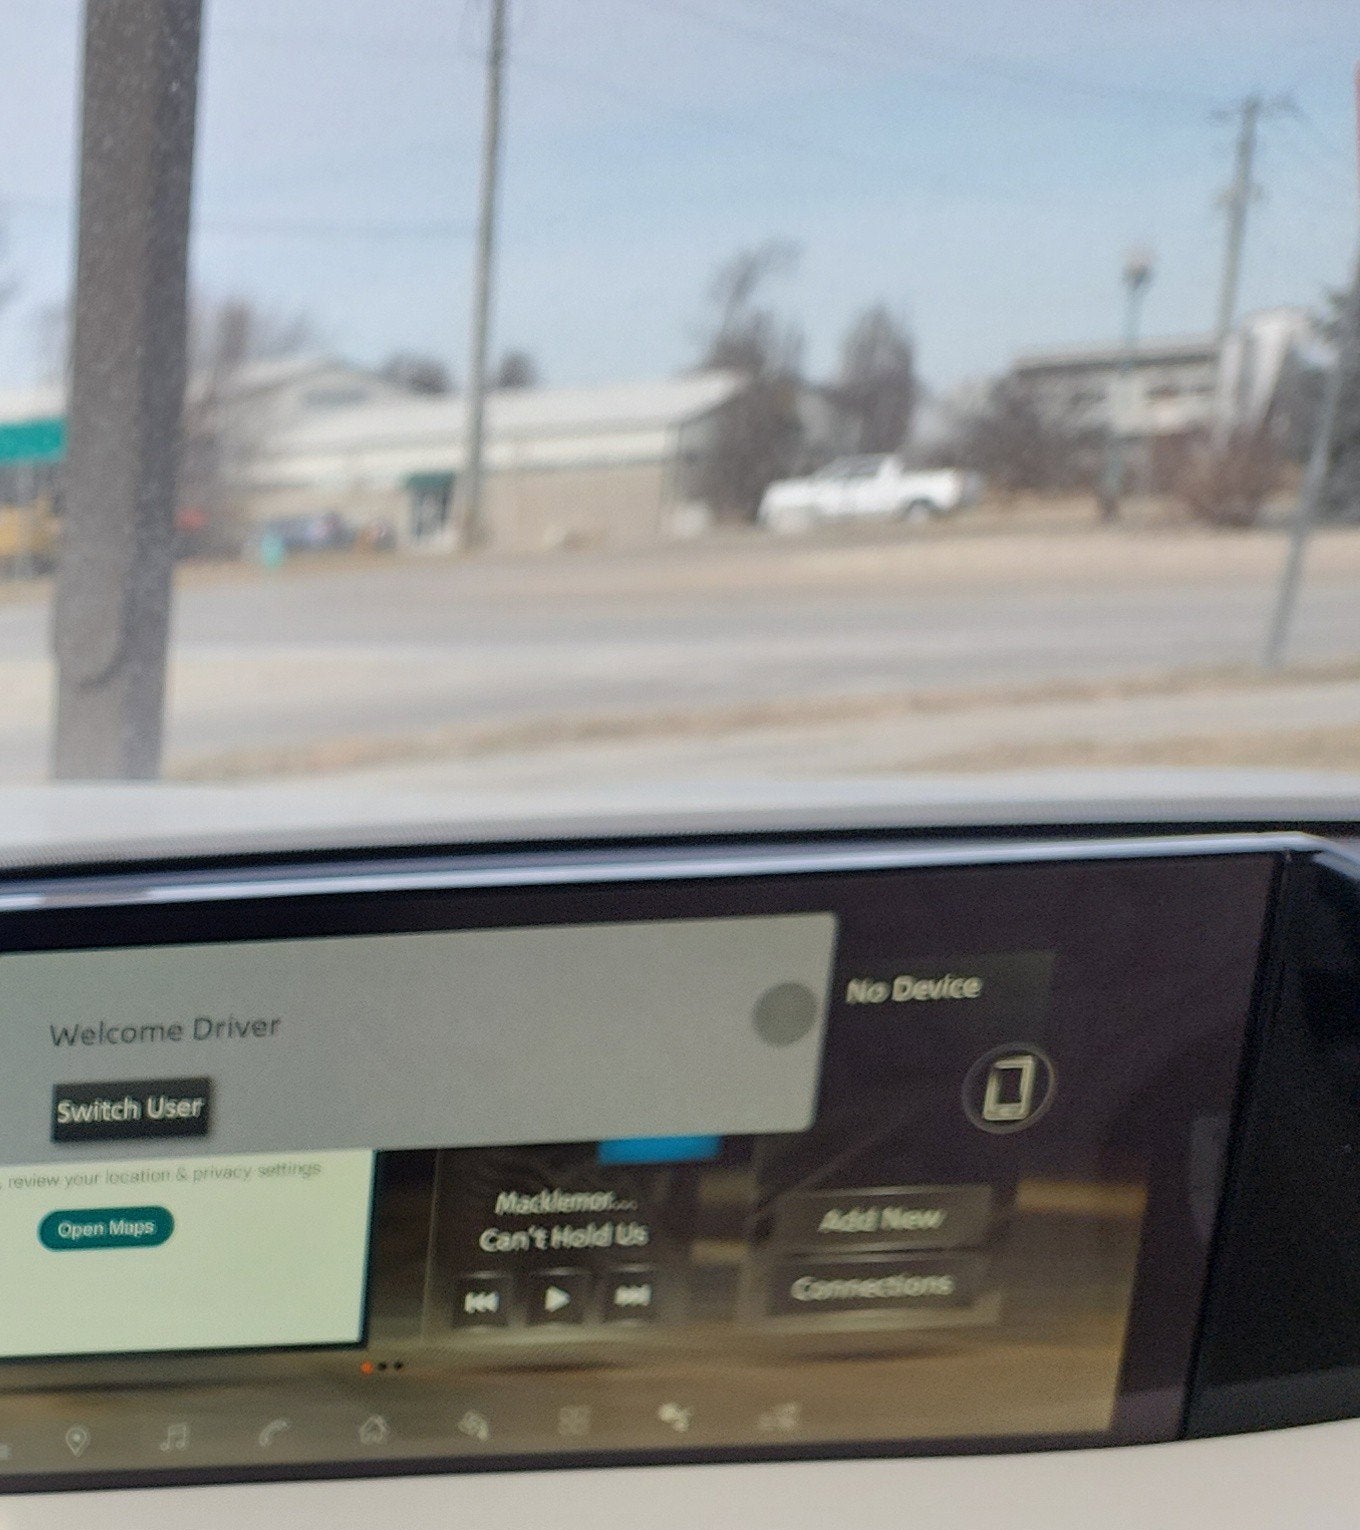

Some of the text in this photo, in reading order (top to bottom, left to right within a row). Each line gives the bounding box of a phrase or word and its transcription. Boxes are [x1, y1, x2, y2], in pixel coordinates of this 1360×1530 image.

[846, 973, 983, 1005] No Device
[50, 1017, 281, 1047] Welcome Driver
[57, 1095, 204, 1124] Switch User
[8, 1173, 59, 1189] review
[64, 1174, 100, 1188] your
[105, 1168, 171, 1185] location
[193, 1165, 252, 1184] privacy
[257, 1161, 322, 1180] settings
[57, 1219, 156, 1240] Open Maps
[818, 1207, 948, 1233] Add New
[480, 1220, 650, 1252] Can't Hold Us
[790, 1274, 956, 1301] Connections
